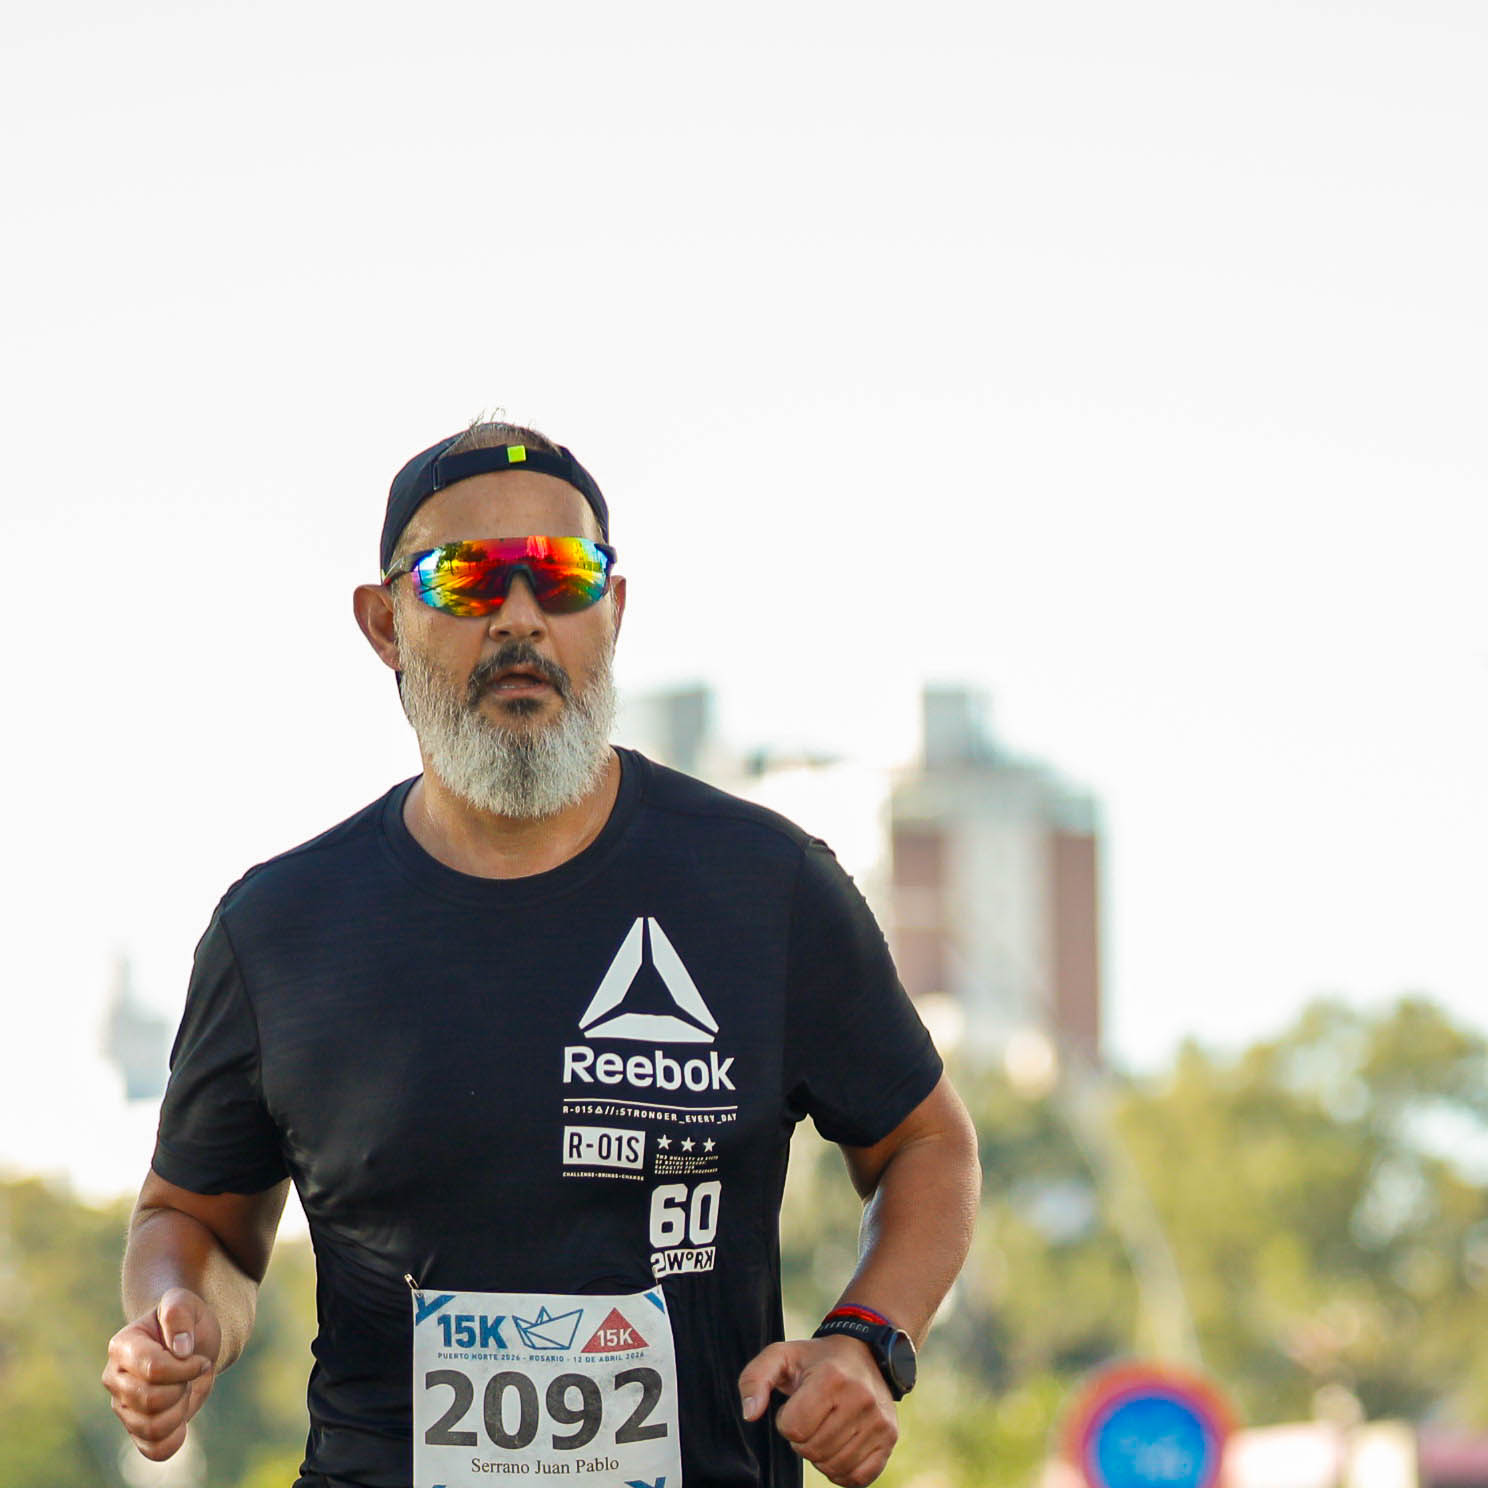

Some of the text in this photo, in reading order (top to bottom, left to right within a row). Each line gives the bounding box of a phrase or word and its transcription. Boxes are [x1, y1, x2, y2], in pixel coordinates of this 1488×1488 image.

[562, 1045, 737, 1092] Reebok
[568, 1131, 640, 1164] R-01S
[649, 1180, 722, 1249] 60
[437, 1314, 508, 1350] 15K
[596, 1327, 633, 1347] 15K
[438, 1353, 469, 1361] PUERTO
[472, 1353, 498, 1361] NORTE
[529, 1354, 564, 1362] ROSARIO
[599, 1354, 622, 1362] ABRIL
[425, 1367, 668, 1450] 2092
[471, 1457, 619, 1475] Serrano Juan Pablo
